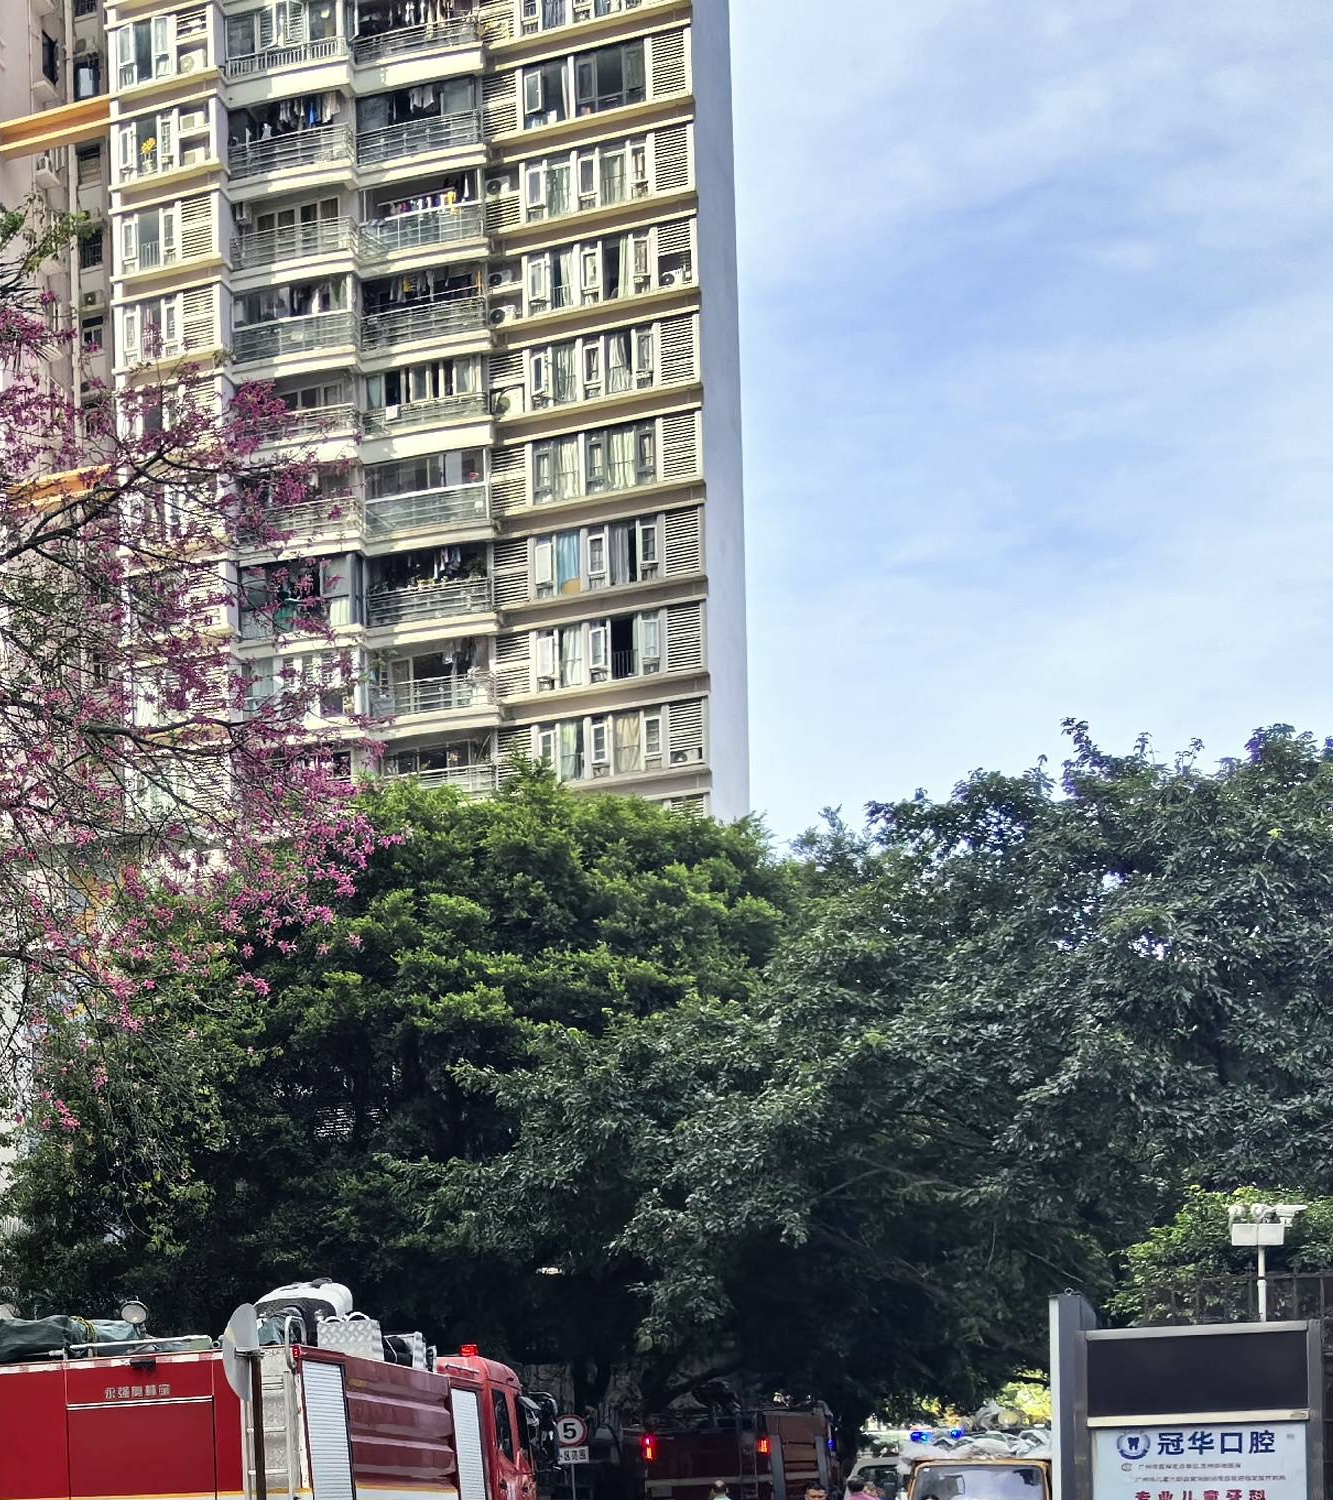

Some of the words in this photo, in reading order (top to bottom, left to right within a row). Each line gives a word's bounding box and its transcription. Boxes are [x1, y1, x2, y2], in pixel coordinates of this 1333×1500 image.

[563, 1422, 577, 1440] 5
[1157, 1429, 1276, 1456] 冠华口腔
